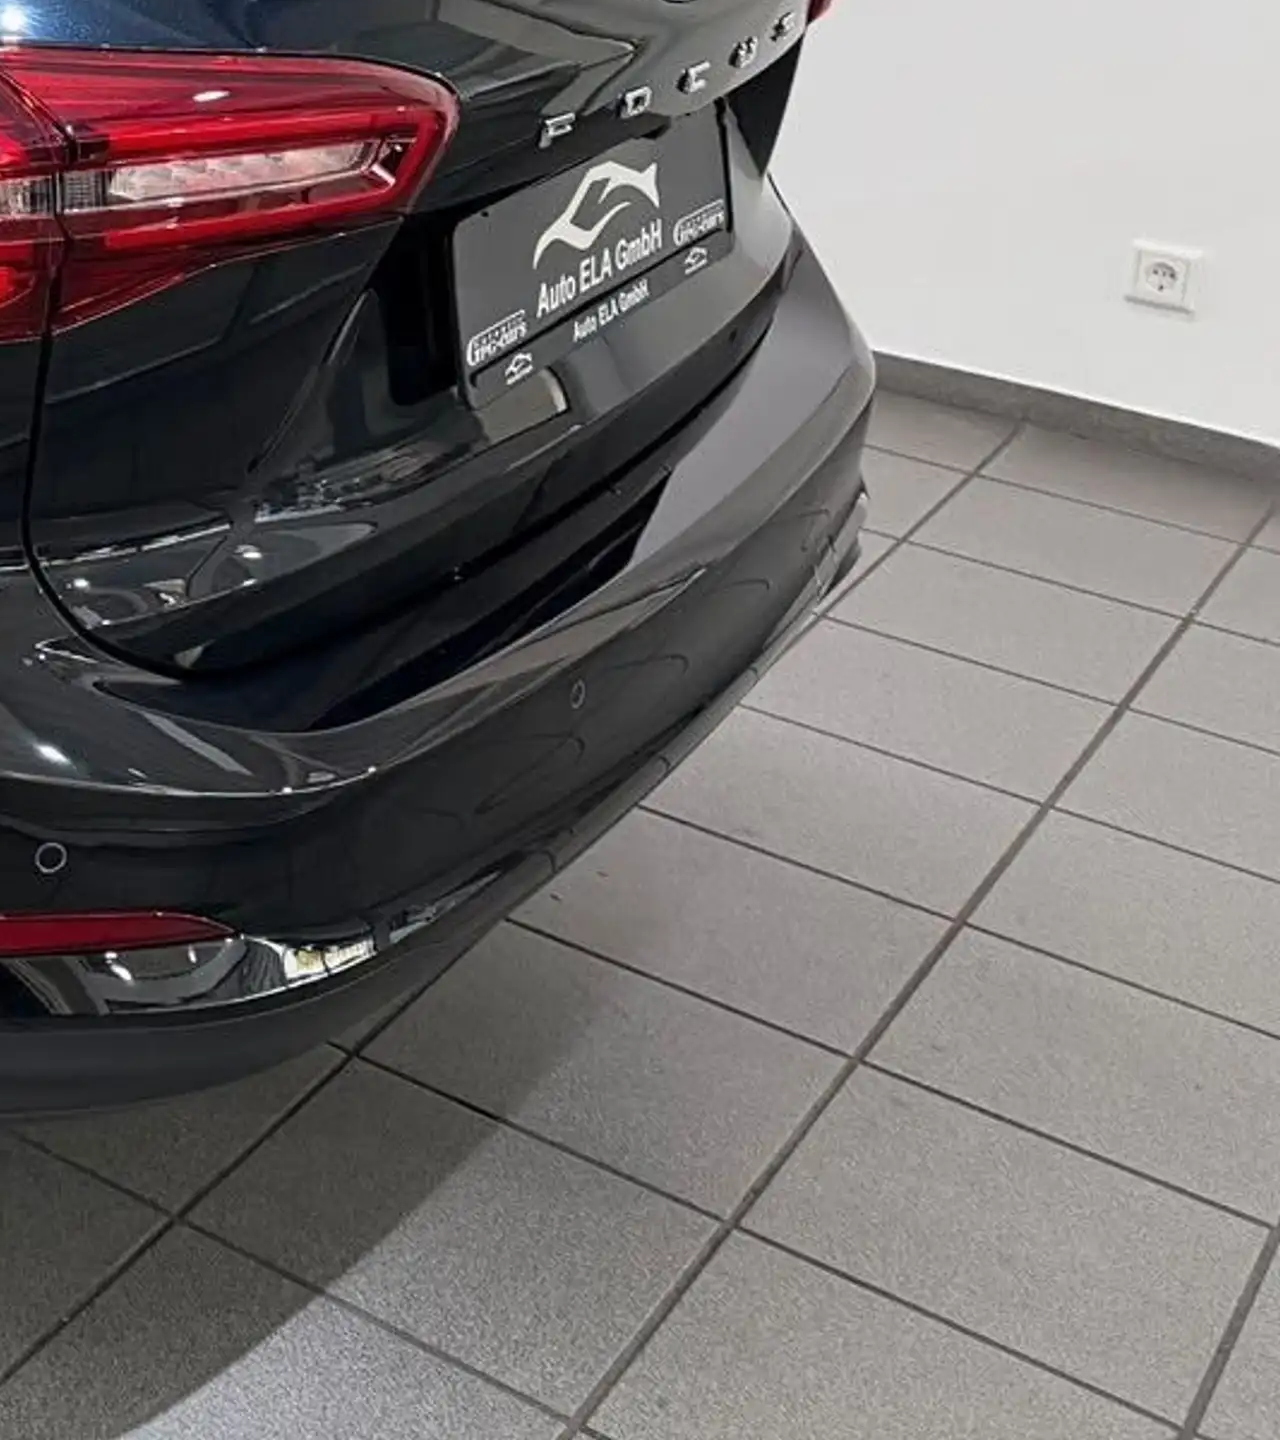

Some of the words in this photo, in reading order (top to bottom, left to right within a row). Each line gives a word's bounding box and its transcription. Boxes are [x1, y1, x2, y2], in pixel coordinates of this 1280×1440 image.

[536, 273, 576, 318] Auto
[579, 247, 612, 293] ELA
[614, 218, 662, 271] GmbH
[572, 316, 597, 342] Auto
[598, 298, 619, 326] ELA
[618, 278, 649, 312] GmbH
